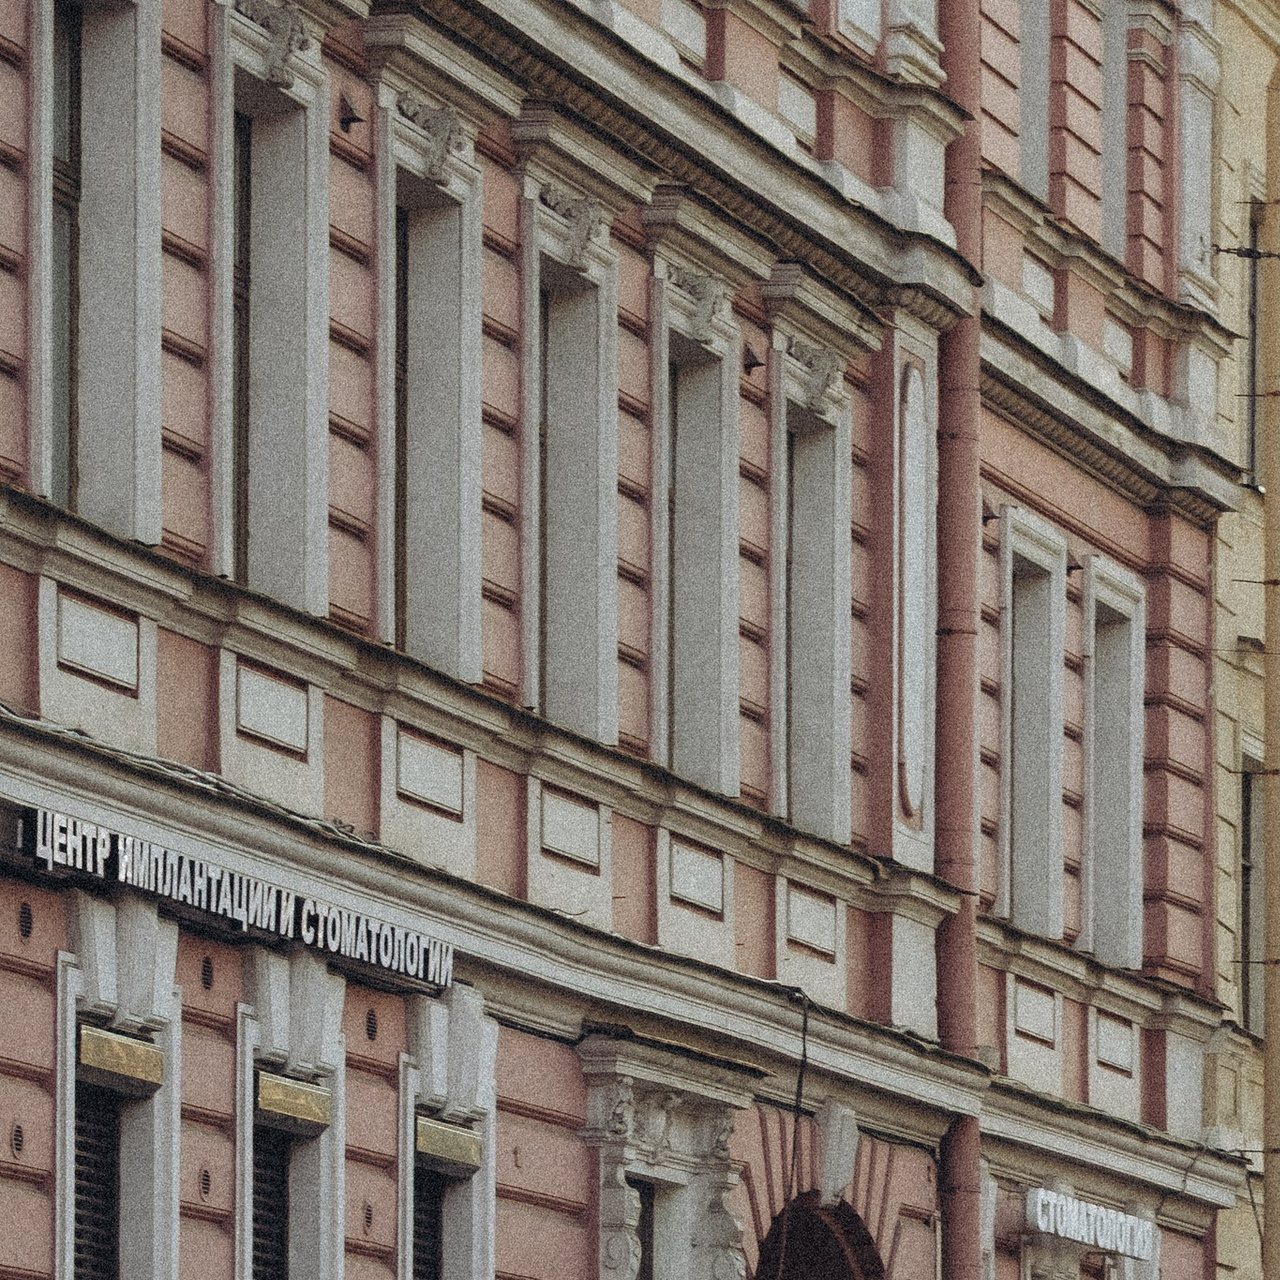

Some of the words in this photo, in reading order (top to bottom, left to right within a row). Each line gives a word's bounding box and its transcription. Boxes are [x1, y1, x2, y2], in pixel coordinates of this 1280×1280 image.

[36, 809, 111, 878] ЦЕНТР
[118, 834, 277, 933] ИМПЛАНТАЦИИ
[279, 889, 296, 938] И
[302, 899, 455, 986] СТОМАТОЛОГИИ
[1037, 1188, 1153, 1261] СТОМАТОЛОГИЯ
